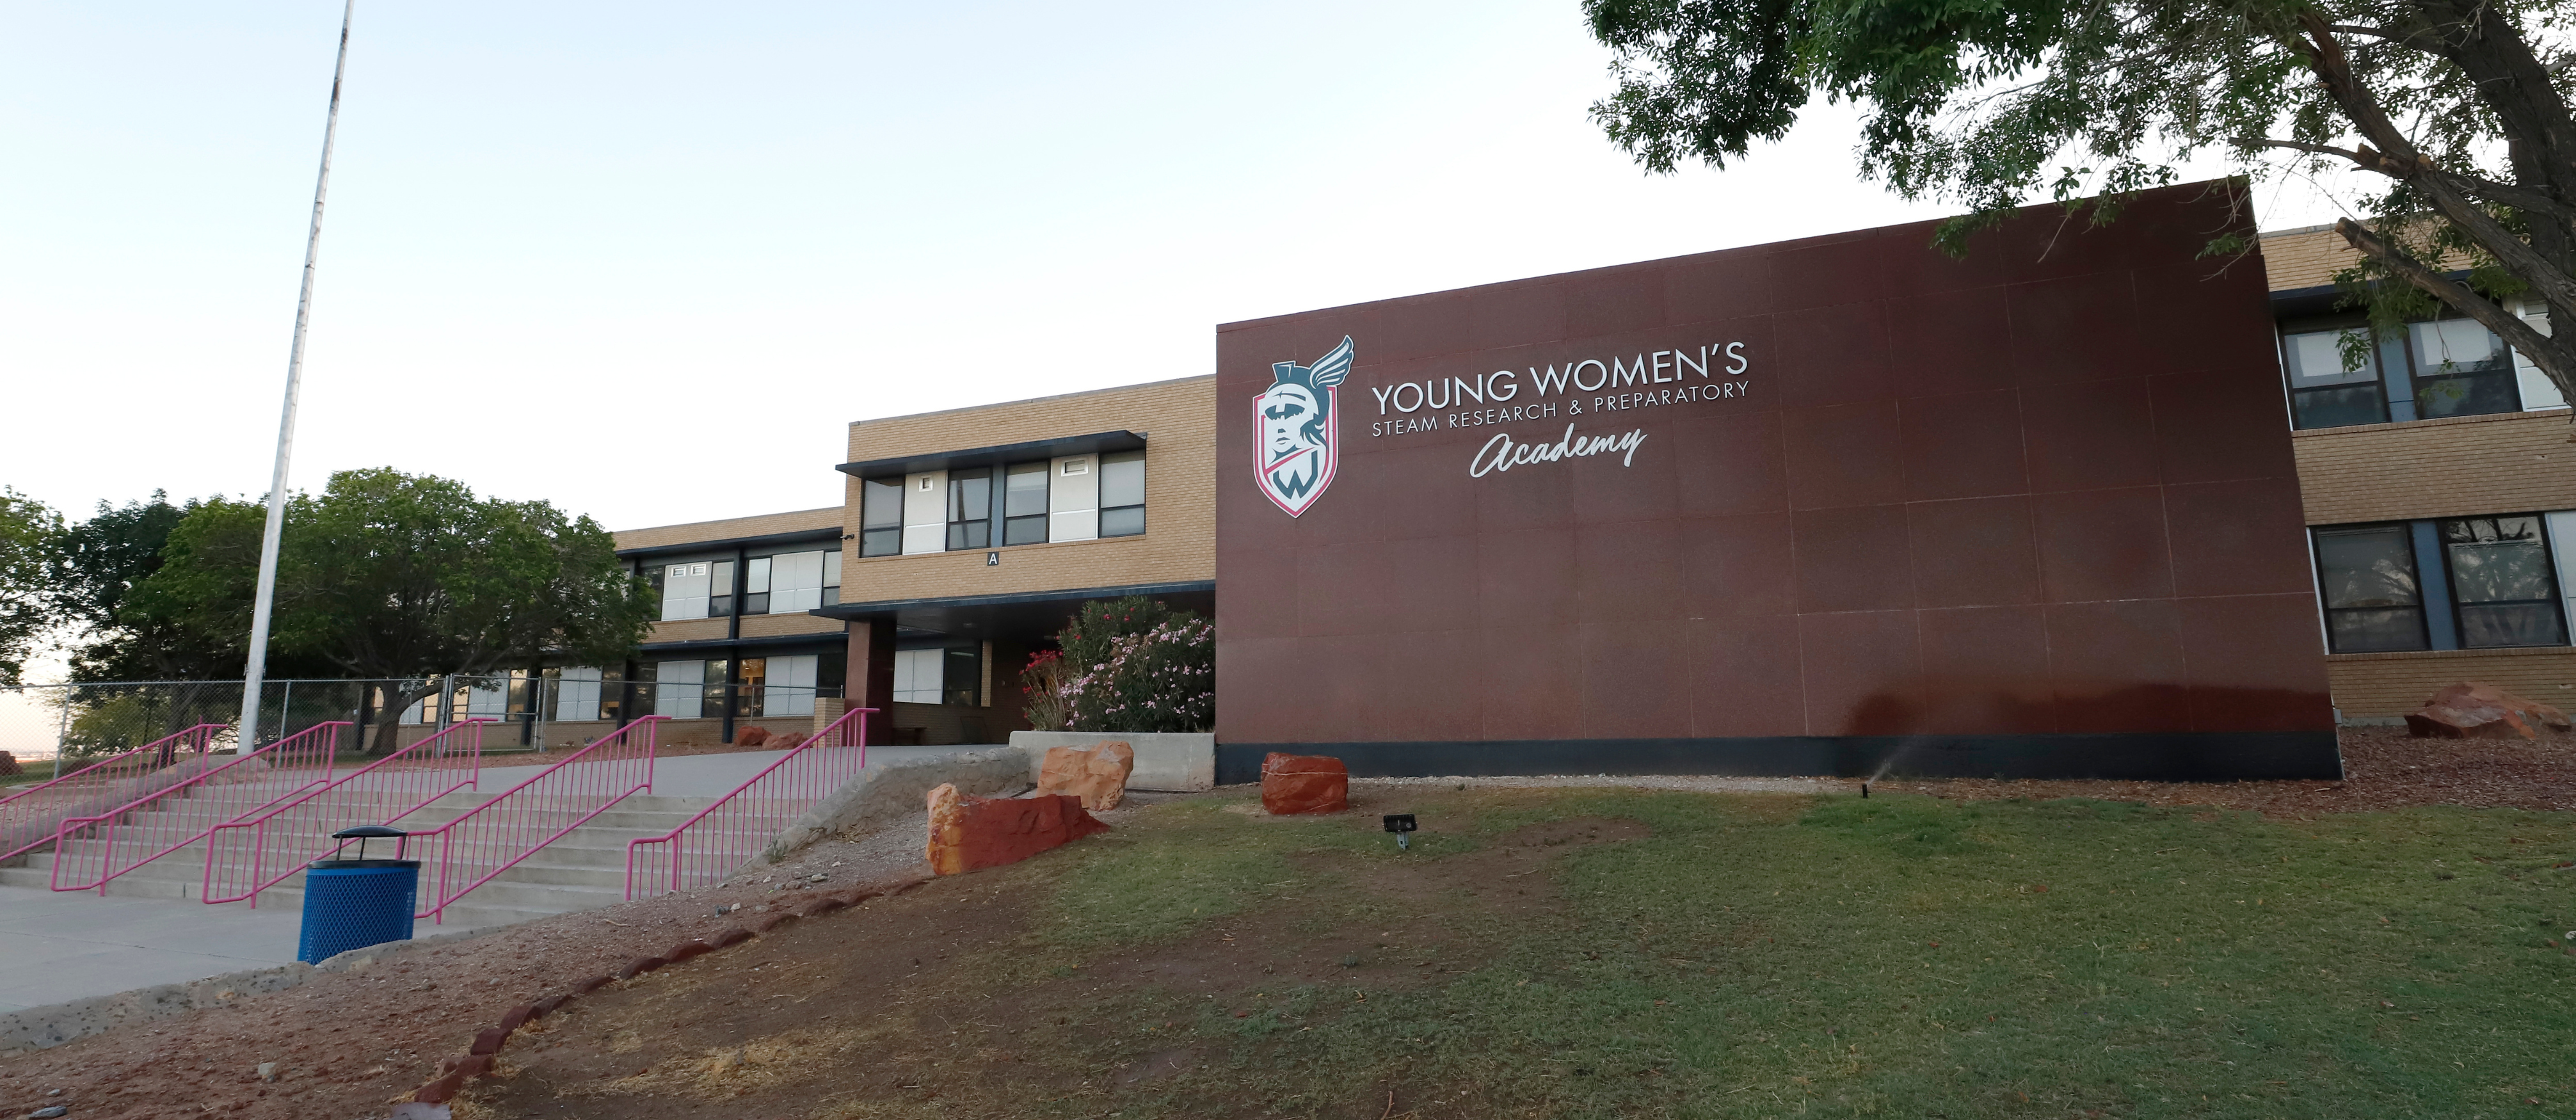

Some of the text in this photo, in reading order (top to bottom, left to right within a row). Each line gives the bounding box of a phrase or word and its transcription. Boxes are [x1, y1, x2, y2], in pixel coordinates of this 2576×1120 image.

[1371, 341, 1748, 415] YOUNG WOMEN'S
[1372, 380, 1749, 437] STEAM RESEARCH & PREPARATORY
[1469, 422, 1648, 478] Academy
[988, 553, 998, 565] A
